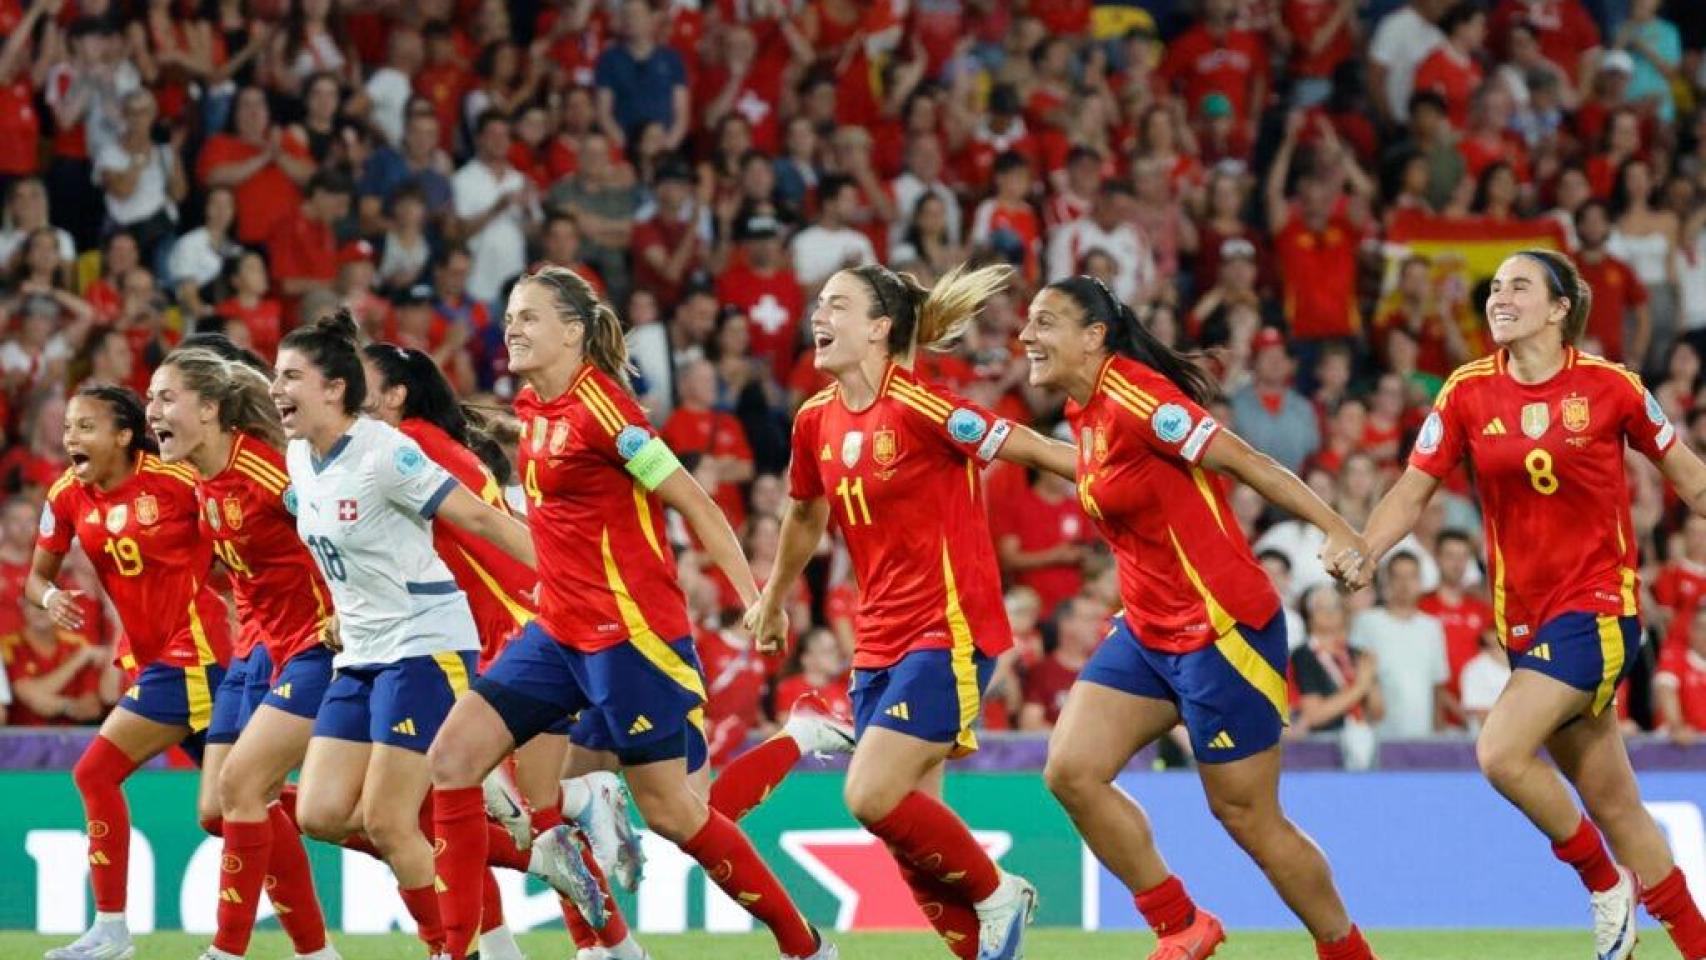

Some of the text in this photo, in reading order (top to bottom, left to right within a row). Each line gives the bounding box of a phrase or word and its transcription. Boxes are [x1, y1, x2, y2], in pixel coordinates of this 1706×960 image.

[525, 459, 543, 508] 4
[1525, 448, 1559, 495] 8
[835, 476, 872, 526] 11
[104, 536, 144, 577] 19
[213, 539, 254, 579] 14
[308, 534, 346, 581] 18
